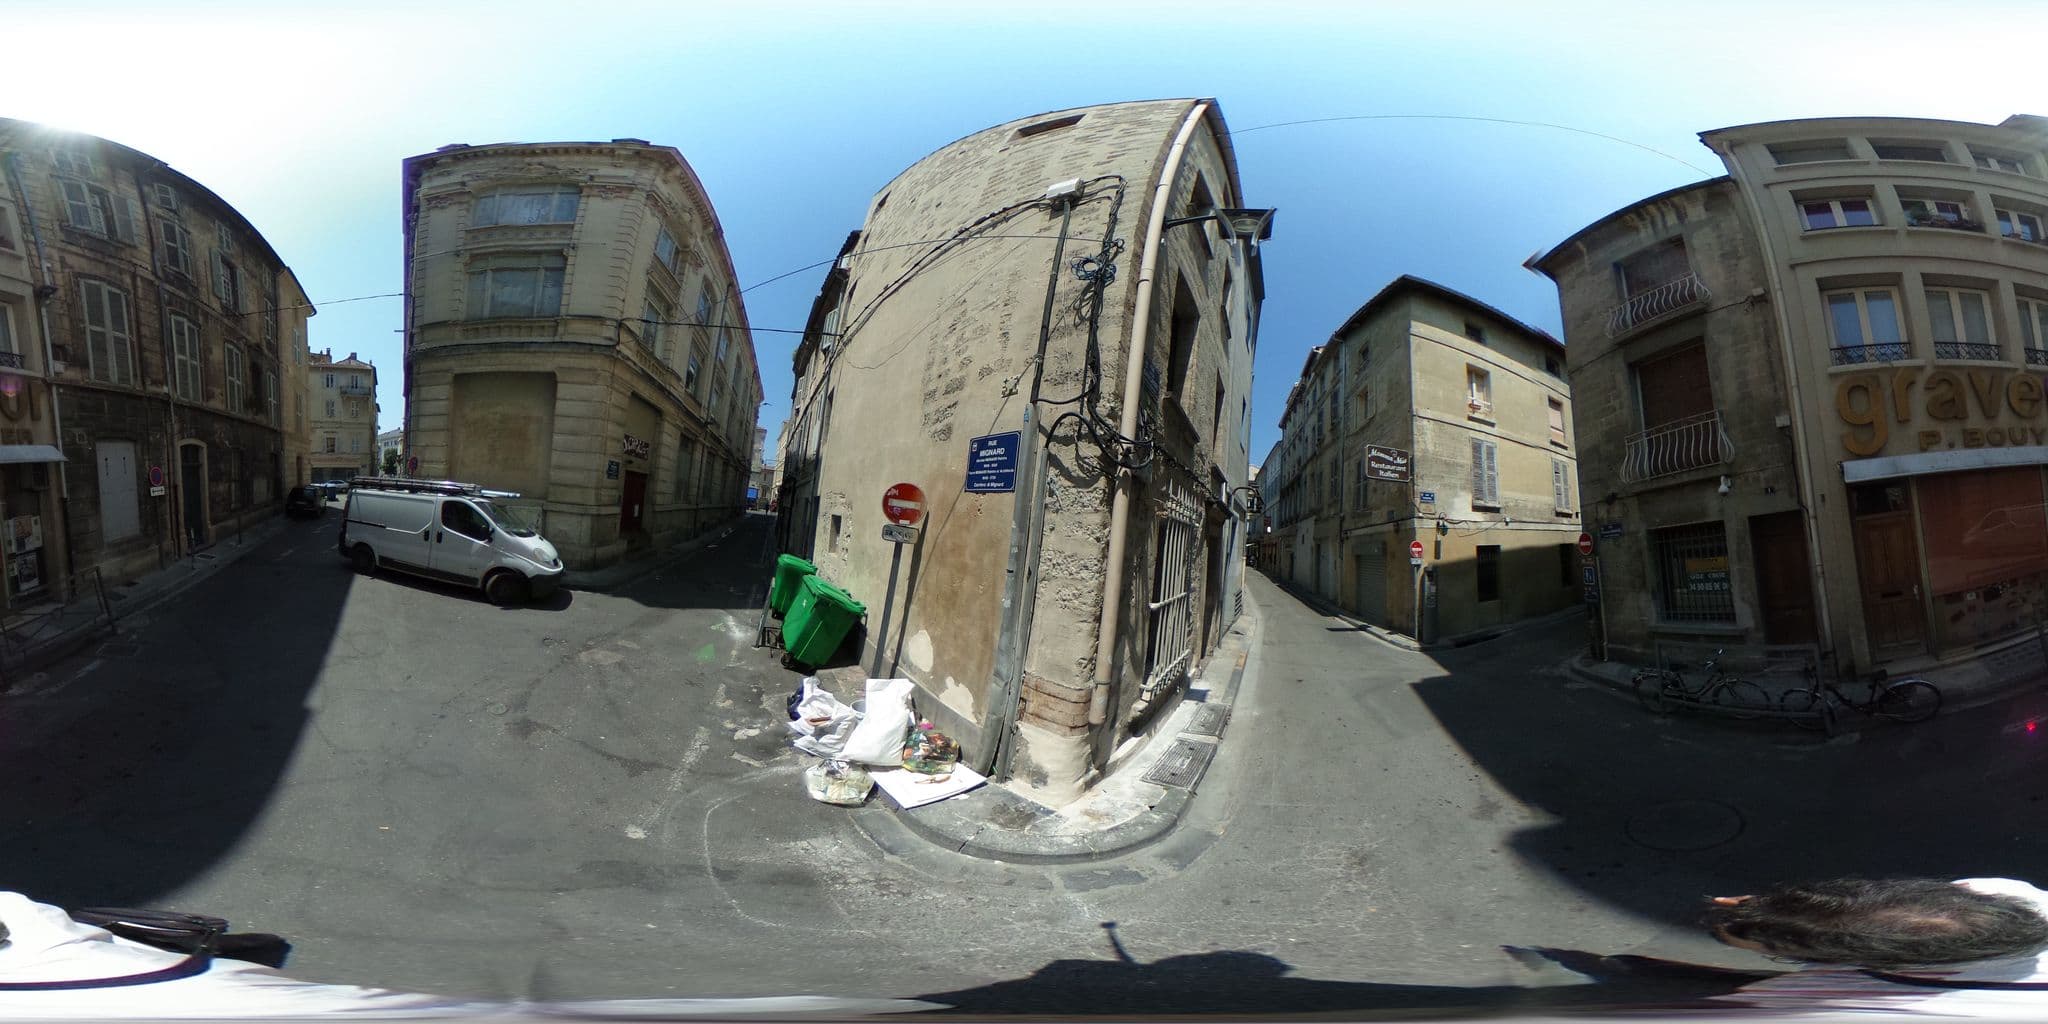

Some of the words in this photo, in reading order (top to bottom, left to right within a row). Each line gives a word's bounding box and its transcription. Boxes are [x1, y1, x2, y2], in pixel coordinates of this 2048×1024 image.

[1836, 366, 2048, 458] grave
[979, 448, 1006, 457] MIGNARD
[1371, 461, 1407, 472] Restaurant
[1379, 470, 1400, 479] Italien
